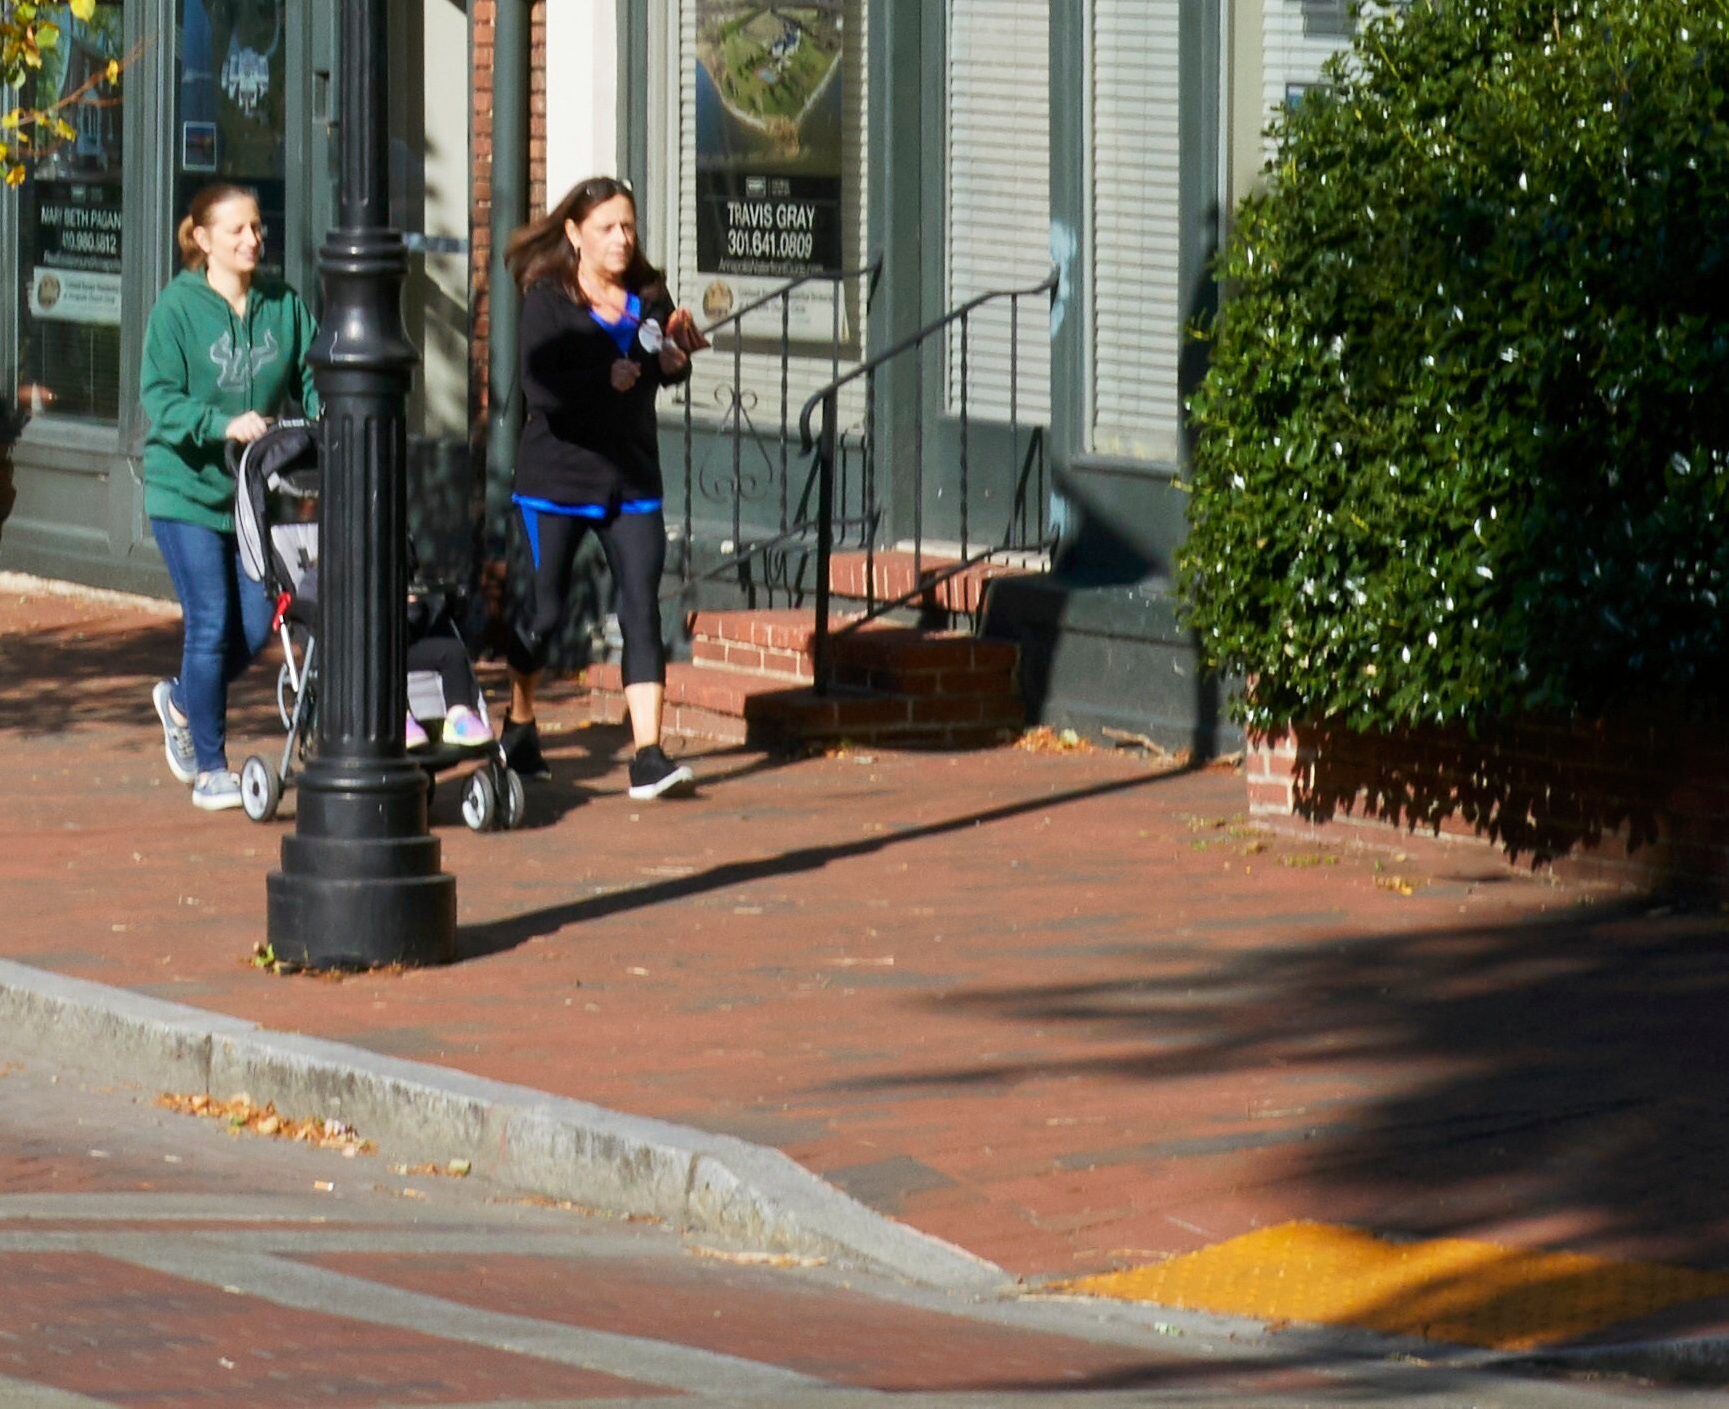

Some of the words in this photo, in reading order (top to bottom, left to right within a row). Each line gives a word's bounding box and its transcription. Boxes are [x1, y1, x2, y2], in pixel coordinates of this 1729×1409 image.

[727, 200, 773, 229] TRAVIS
[776, 203, 816, 231] GRAY
[727, 228, 813, 260] 301.641.0809
